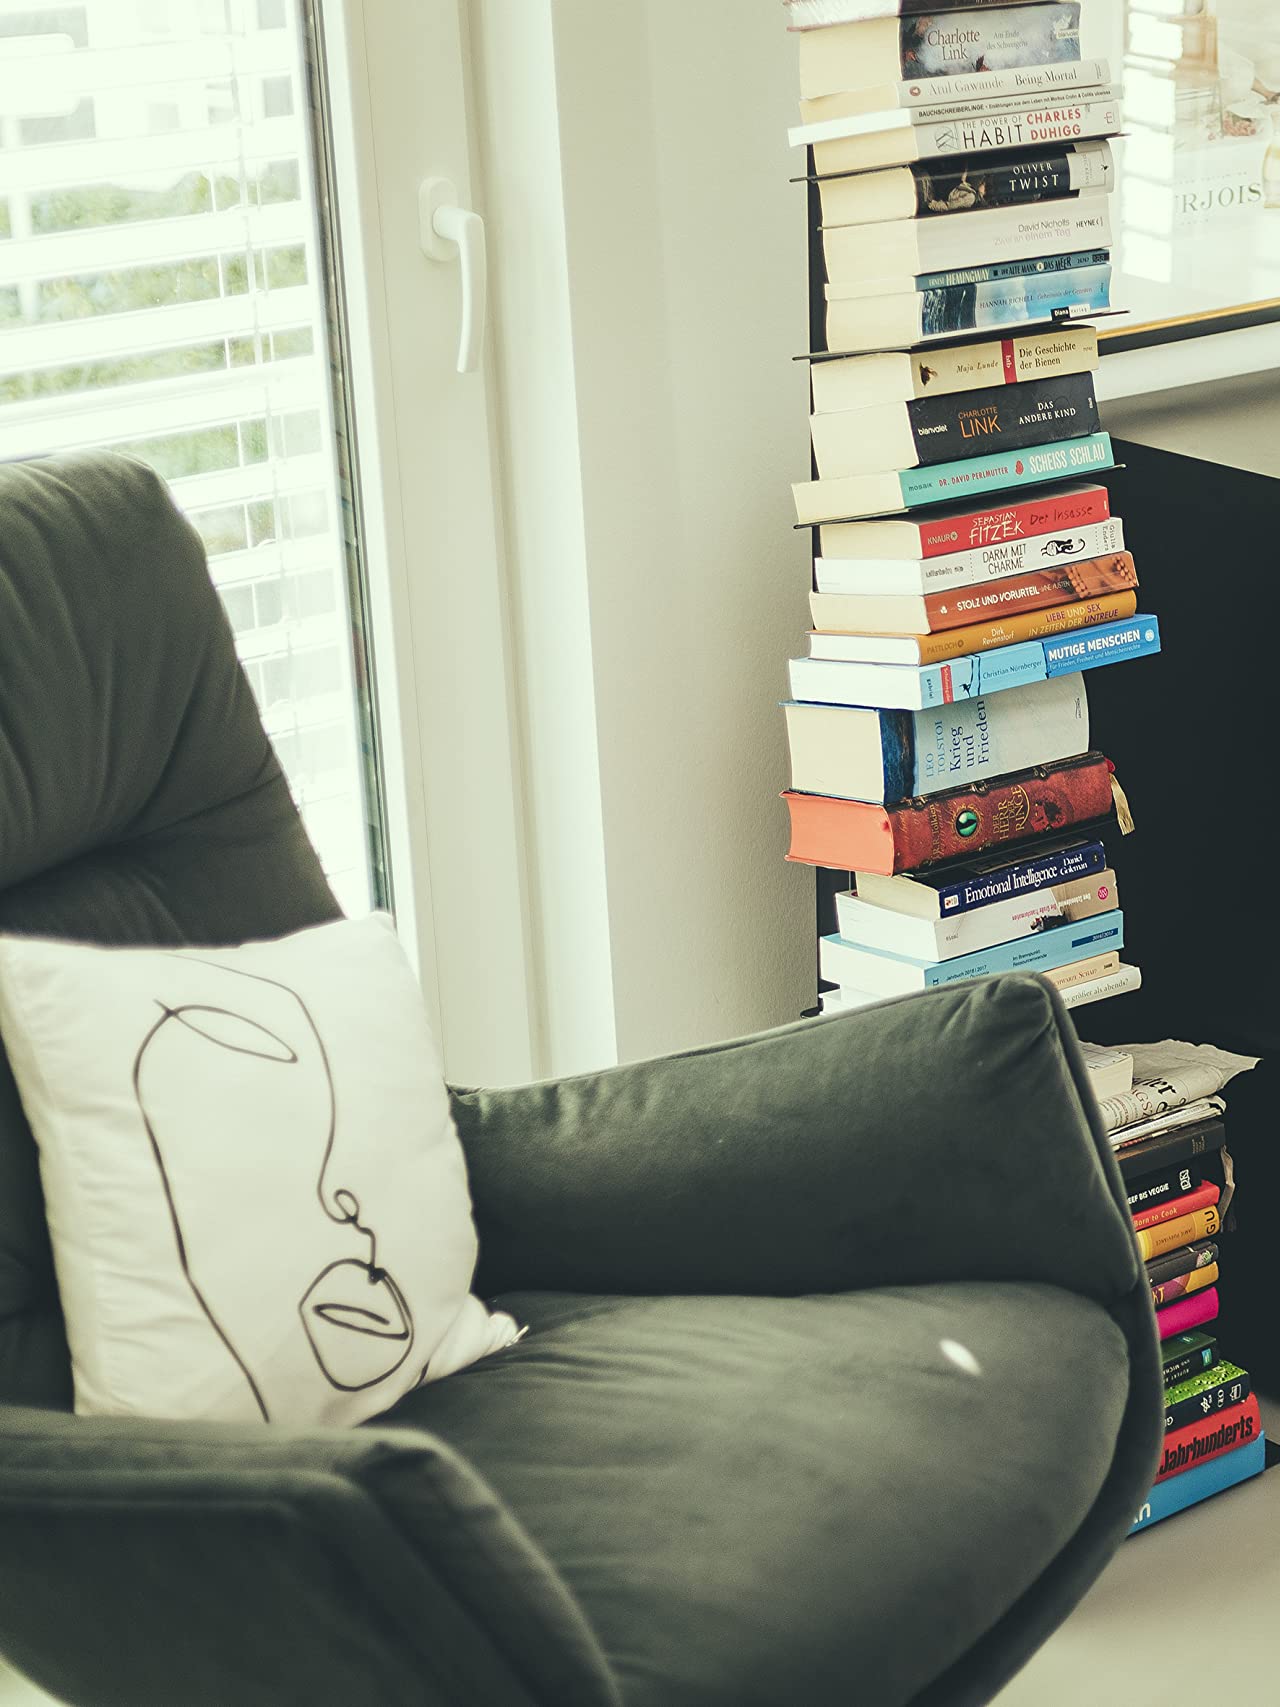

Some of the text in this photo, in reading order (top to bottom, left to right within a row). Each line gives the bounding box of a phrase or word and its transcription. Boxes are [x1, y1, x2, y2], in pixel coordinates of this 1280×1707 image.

[927, 28, 980, 47] Charlotte
[1004, 30, 1019, 39] Ende
[942, 45, 968, 61] Link
[929, 77, 1004, 96] Atul Gawande
[1014, 73, 1042, 87] Being
[1044, 67, 1077, 83] Mortal
[918, 104, 984, 118] BAUCHSCHREIBERLINGE
[1026, 108, 1081, 125] CHARLES
[962, 114, 1022, 129] THE POWER OF
[962, 124, 1023, 149] HABIT
[1030, 124, 1081, 141] DUHIGG
[1013, 162, 1053, 175] OLIVER
[1009, 174, 1059, 192] TWIST
[1175, 182, 1262, 213] RJOIS
[1018, 218, 1070, 233] David Nicholls
[1076, 218, 1096, 229] HEYNE
[1025, 230, 1052, 242] einem
[1054, 227, 1072, 239] Tag
[945, 268, 991, 286] HEMINGWAY
[1044, 261, 1055, 270] DAS
[1055, 255, 1072, 270] MEER
[980, 298, 1007, 309] HANNAH
[1019, 342, 1076, 358] Die Geschichte
[956, 360, 999, 374] Maja Lunde
[1019, 357, 1061, 370] der Bienen
[958, 406, 998, 420] CHARLOTTE
[1037, 400, 1054, 411] DAS
[1019, 407, 1077, 425] ANDERE KIND
[917, 423, 948, 437] blanvalet
[959, 415, 1002, 439] LINK
[1029, 442, 1106, 475] SCHEISS SCHLAU
[938, 466, 1009, 487] DR. DAVID PERLMUTTER
[972, 511, 1018, 528] SEBASTIAN
[1029, 513, 1049, 526] Der
[1053, 505, 1093, 521] Insasse
[927, 534, 951, 545] KNAUR
[969, 520, 1025, 545] FITZEK
[982, 543, 1027, 564] DARM MIT
[988, 557, 1025, 575] CHARME
[1052, 579, 1071, 590] AUSTEN
[956, 585, 1040, 612] STOLZ UND VORURTEIL
[1045, 603, 1102, 623] LIEBE UND SEX
[991, 626, 1004, 638] Dirk
[1028, 608, 1119, 638] IN ZEITEN DER UNTREUE
[927, 641, 958, 654] PATTLOCH
[982, 631, 1014, 646] Revenstorf
[1048, 629, 1141, 662] MUTIGE MENSCHEN
[982, 660, 1043, 680] Christian Nürnberger
[976, 700, 990, 765] Frieden
[935, 720, 945, 775] TOLSTOI
[949, 726, 964, 773] Krieg
[963, 734, 975, 769] und
[926, 752, 934, 778] LEO
[1007, 798, 1016, 819] DER
[1011, 785, 1025, 832] RINGE
[929, 803, 940, 834] Tolkien
[992, 813, 1000, 834] DER
[997, 799, 1010, 840] HERR
[1063, 853, 1083, 866] Daniel
[1059, 863, 1088, 876] Goleman
[965, 866, 1058, 904] Emotional Intelligence
[1071, 989, 1093, 1005] größer
[1094, 985, 1103, 995] als
[1103, 978, 1129, 993] abends?
[1127, 1183, 1170, 1204] EEF BIS VEGGIE
[1134, 1207, 1178, 1227] Born to Cook
[1159, 1415, 1254, 1475] Jahrhunderts
